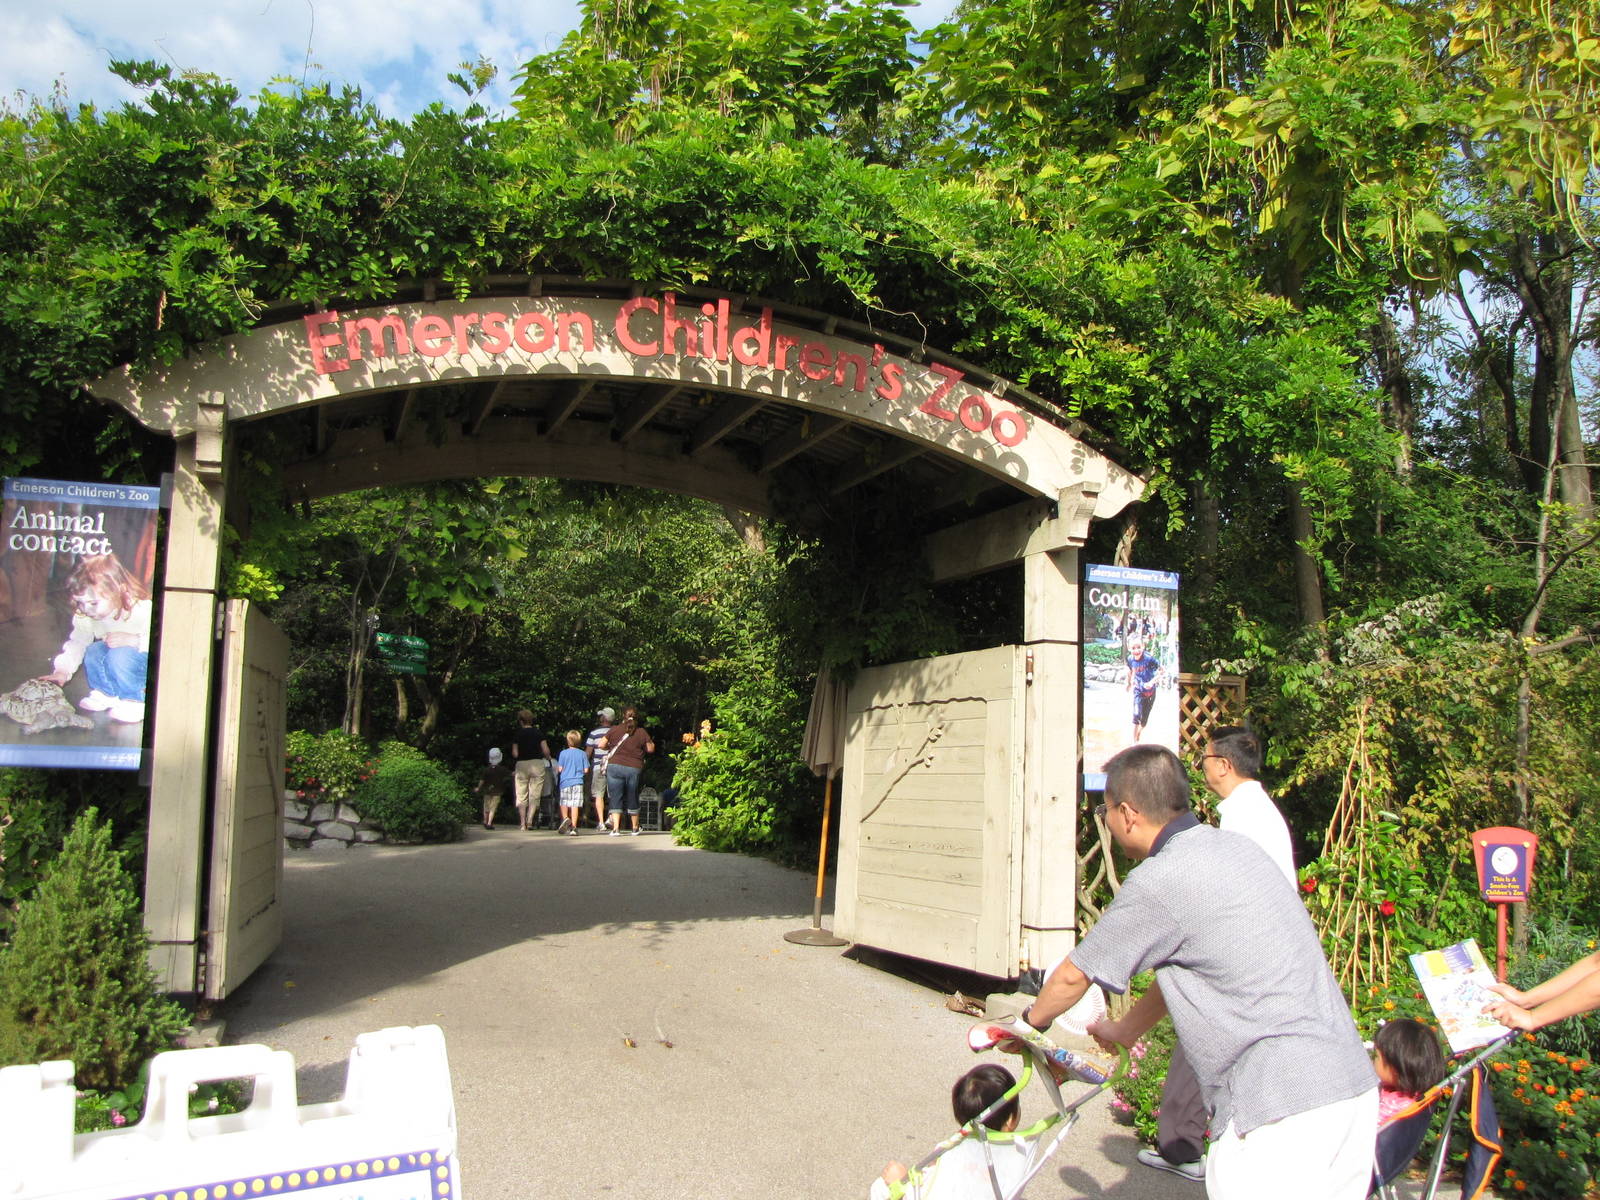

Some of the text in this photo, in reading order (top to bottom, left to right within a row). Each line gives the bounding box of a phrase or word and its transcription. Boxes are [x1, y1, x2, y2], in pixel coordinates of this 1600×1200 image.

[304, 292, 1027, 447] Emerson Children's Zoo
[12, 481, 150, 501] Emerson Children's Zoo
[9, 505, 106, 534] Animal
[9, 533, 113, 556] contact
[1089, 567, 1173, 583] Emerson Children's Zoo
[1089, 587, 1161, 611] Cool fun
